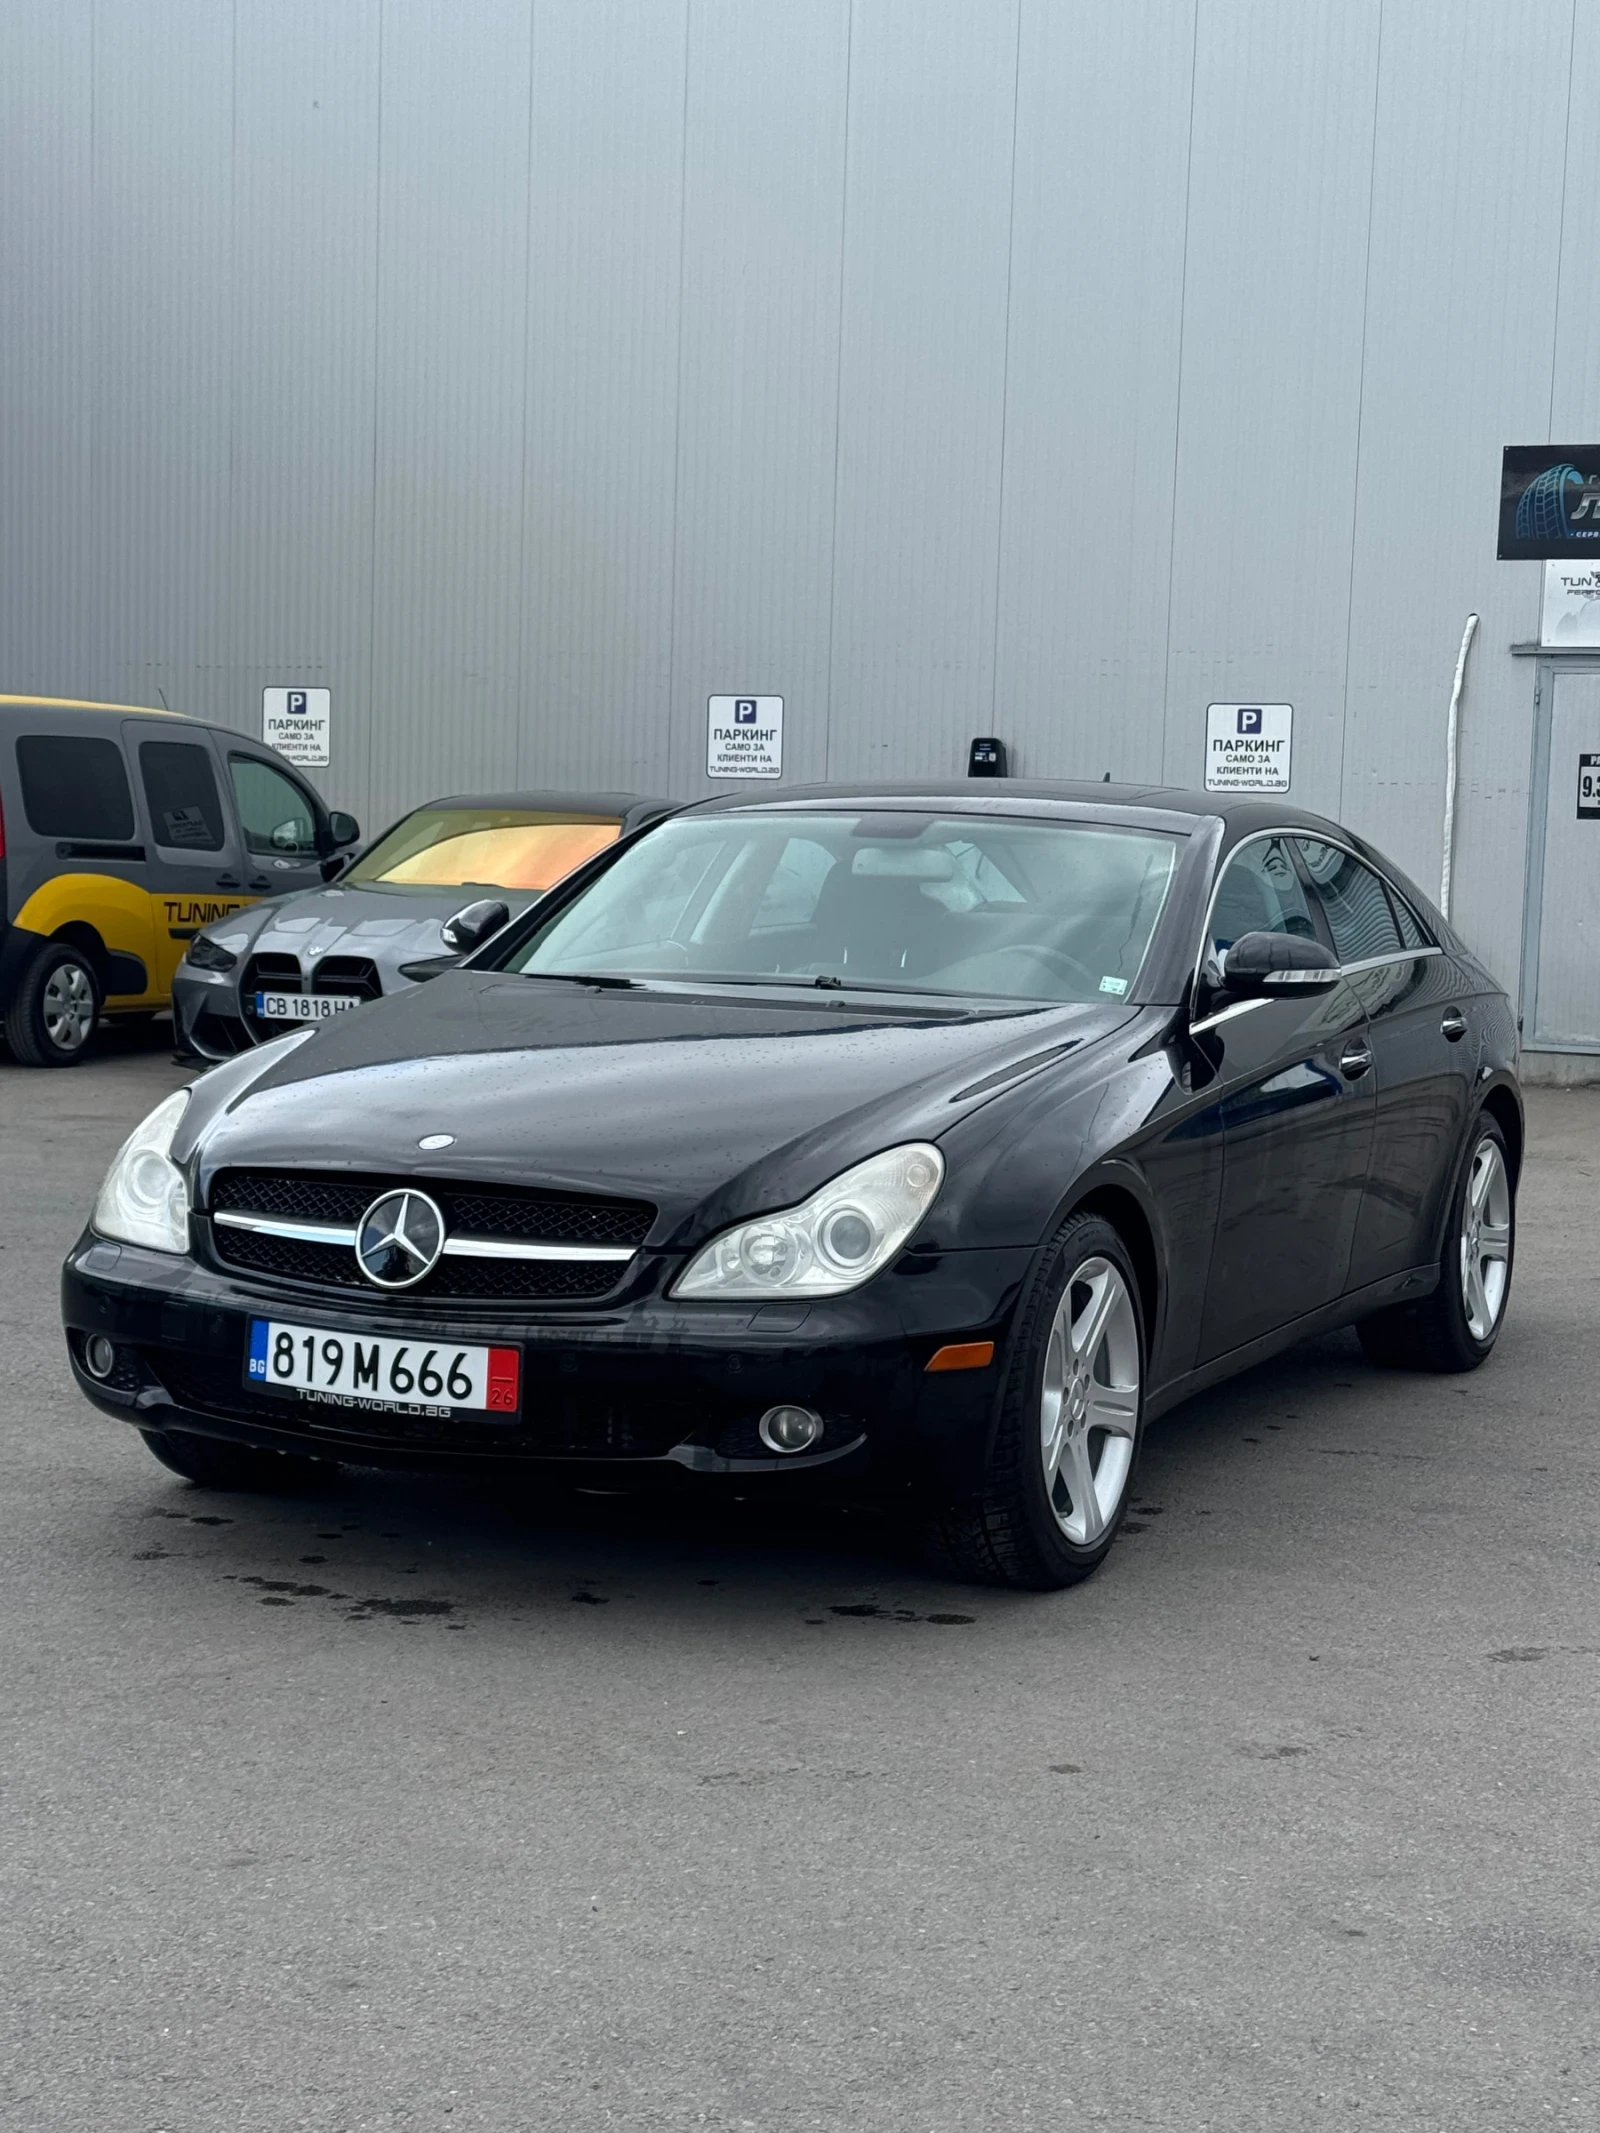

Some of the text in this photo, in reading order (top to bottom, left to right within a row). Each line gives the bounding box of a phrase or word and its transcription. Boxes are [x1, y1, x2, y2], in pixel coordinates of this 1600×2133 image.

[290, 694, 303, 712] P
[739, 702, 753, 721] P
[268, 718, 326, 731] ПАРКИНГ
[1241, 711, 1257, 732] P
[278, 732, 315, 741] САМО ЗА
[713, 728, 777, 741] ПАРКИНГ
[271, 742, 322, 752] КЛИЕНТИ НА
[724, 743, 765, 752] САМО ЗА
[1213, 739, 1286, 752] ПАРКИНГ
[717, 753, 773, 763] КЛИЕНТИ НА
[1225, 754, 1271, 764] САМО ЗА
[1216, 766, 1279, 776] КЛИЕНТИ НА
[1207, 778, 1288, 788] TUNING-WORLD.BG
[266, 997, 287, 1016] CB
[292, 998, 331, 1018] 1818
[249, 1358, 266, 1375] BG
[272, 1331, 473, 1401] 819M666
[296, 1387, 451, 1418] TUNING-WORLD.BG
[490, 1387, 513, 1407] 26
